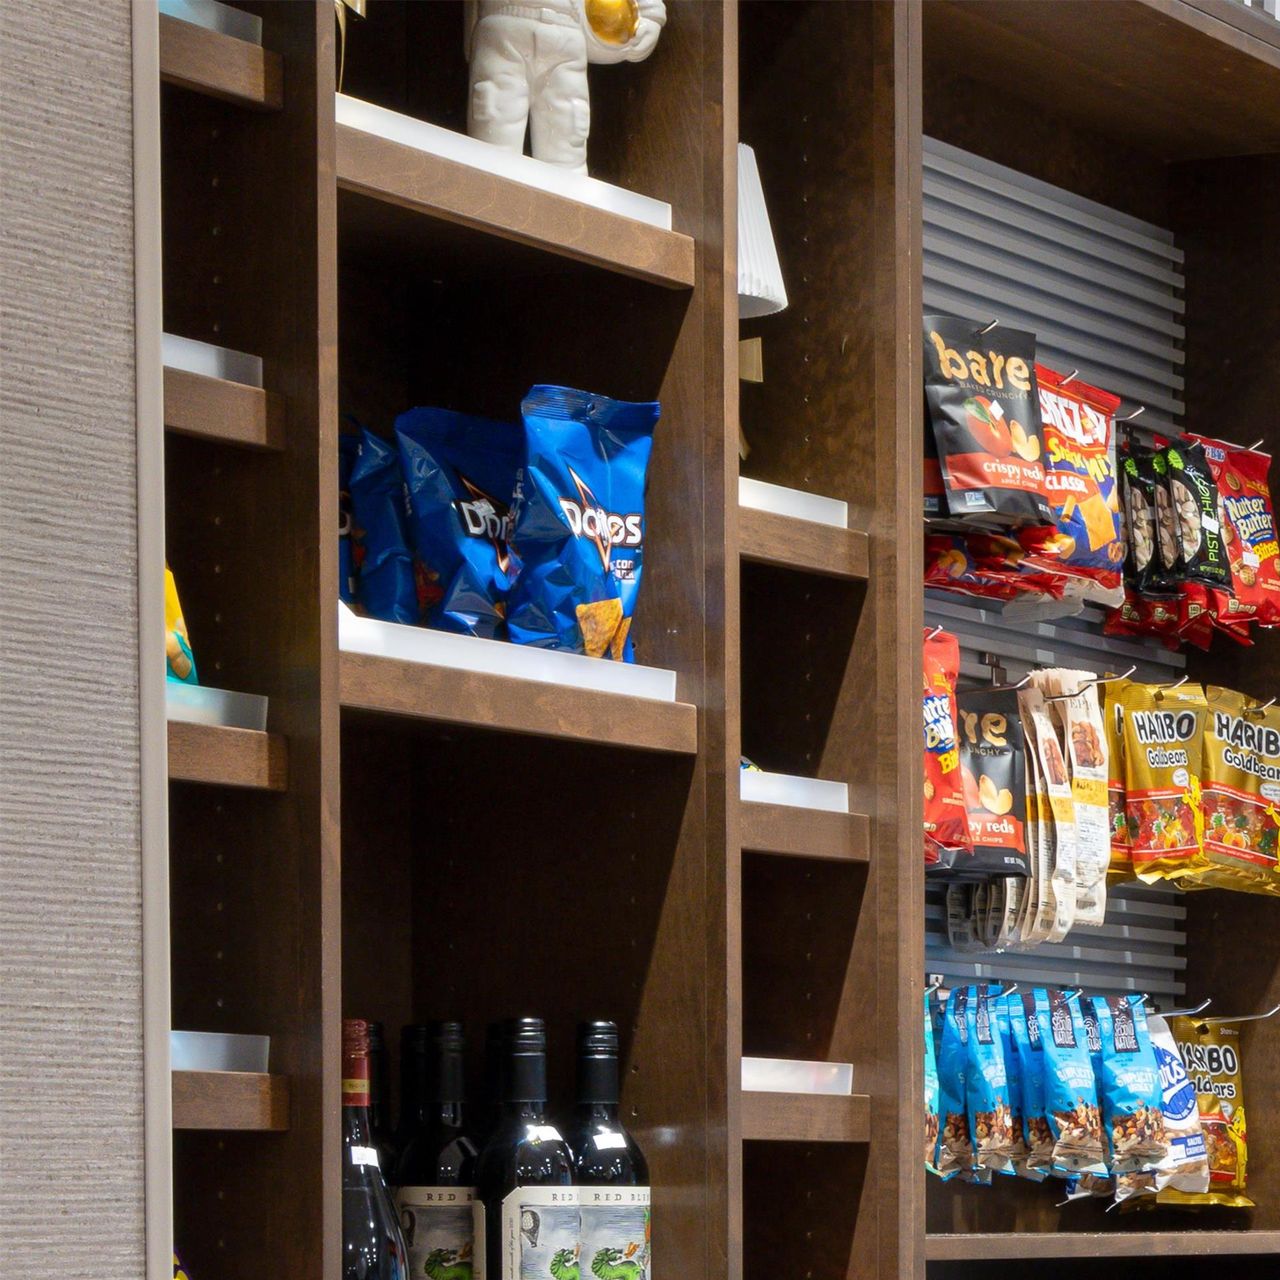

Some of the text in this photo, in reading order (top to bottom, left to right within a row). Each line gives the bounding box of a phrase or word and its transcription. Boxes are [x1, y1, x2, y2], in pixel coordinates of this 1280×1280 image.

[930, 331, 1031, 391] bare
[983, 459, 1021, 480] crispy
[1197, 477, 1220, 562] PISTCHIOS
[1226, 495, 1266, 523] Nutter
[1237, 510, 1273, 540] Butter
[1253, 541, 1280, 561] Bites
[1070, 698, 1094, 712] EPI
[959, 709, 1008, 747] re
[986, 819, 1015, 835] reds
[1178, 1043, 1238, 1076] ARBO
[1190, 1076, 1236, 1098] oldars
[427, 1193, 456, 1201] RED
[594, 1193, 622, 1201] RED
